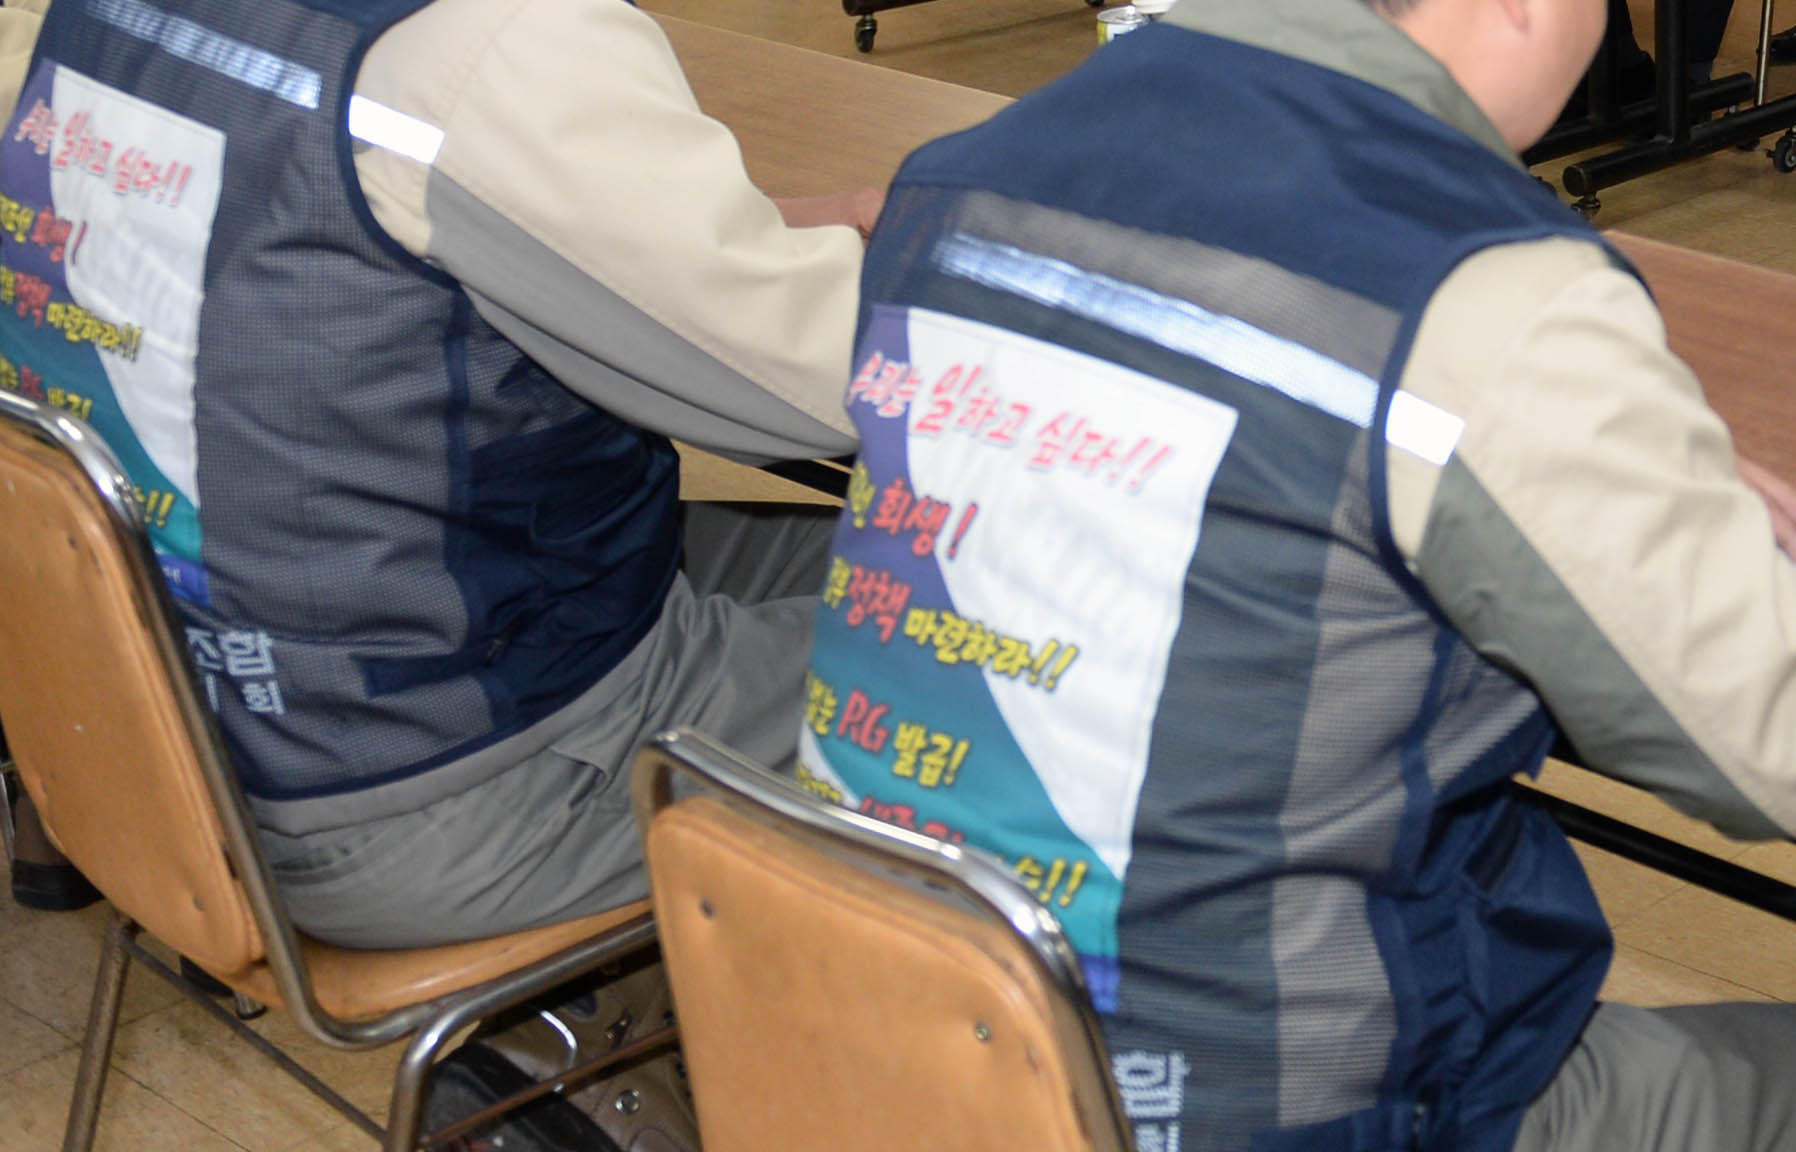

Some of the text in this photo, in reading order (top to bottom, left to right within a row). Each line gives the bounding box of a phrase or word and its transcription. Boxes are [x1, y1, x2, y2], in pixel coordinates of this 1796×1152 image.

[914, 364, 1030, 442] 일하고
[1030, 412, 1174, 493] 싶다!!
[904, 608, 1079, 692] 마련하라!!
[837, 687, 891, 753] RG
[893, 721, 972, 789] 발급!
